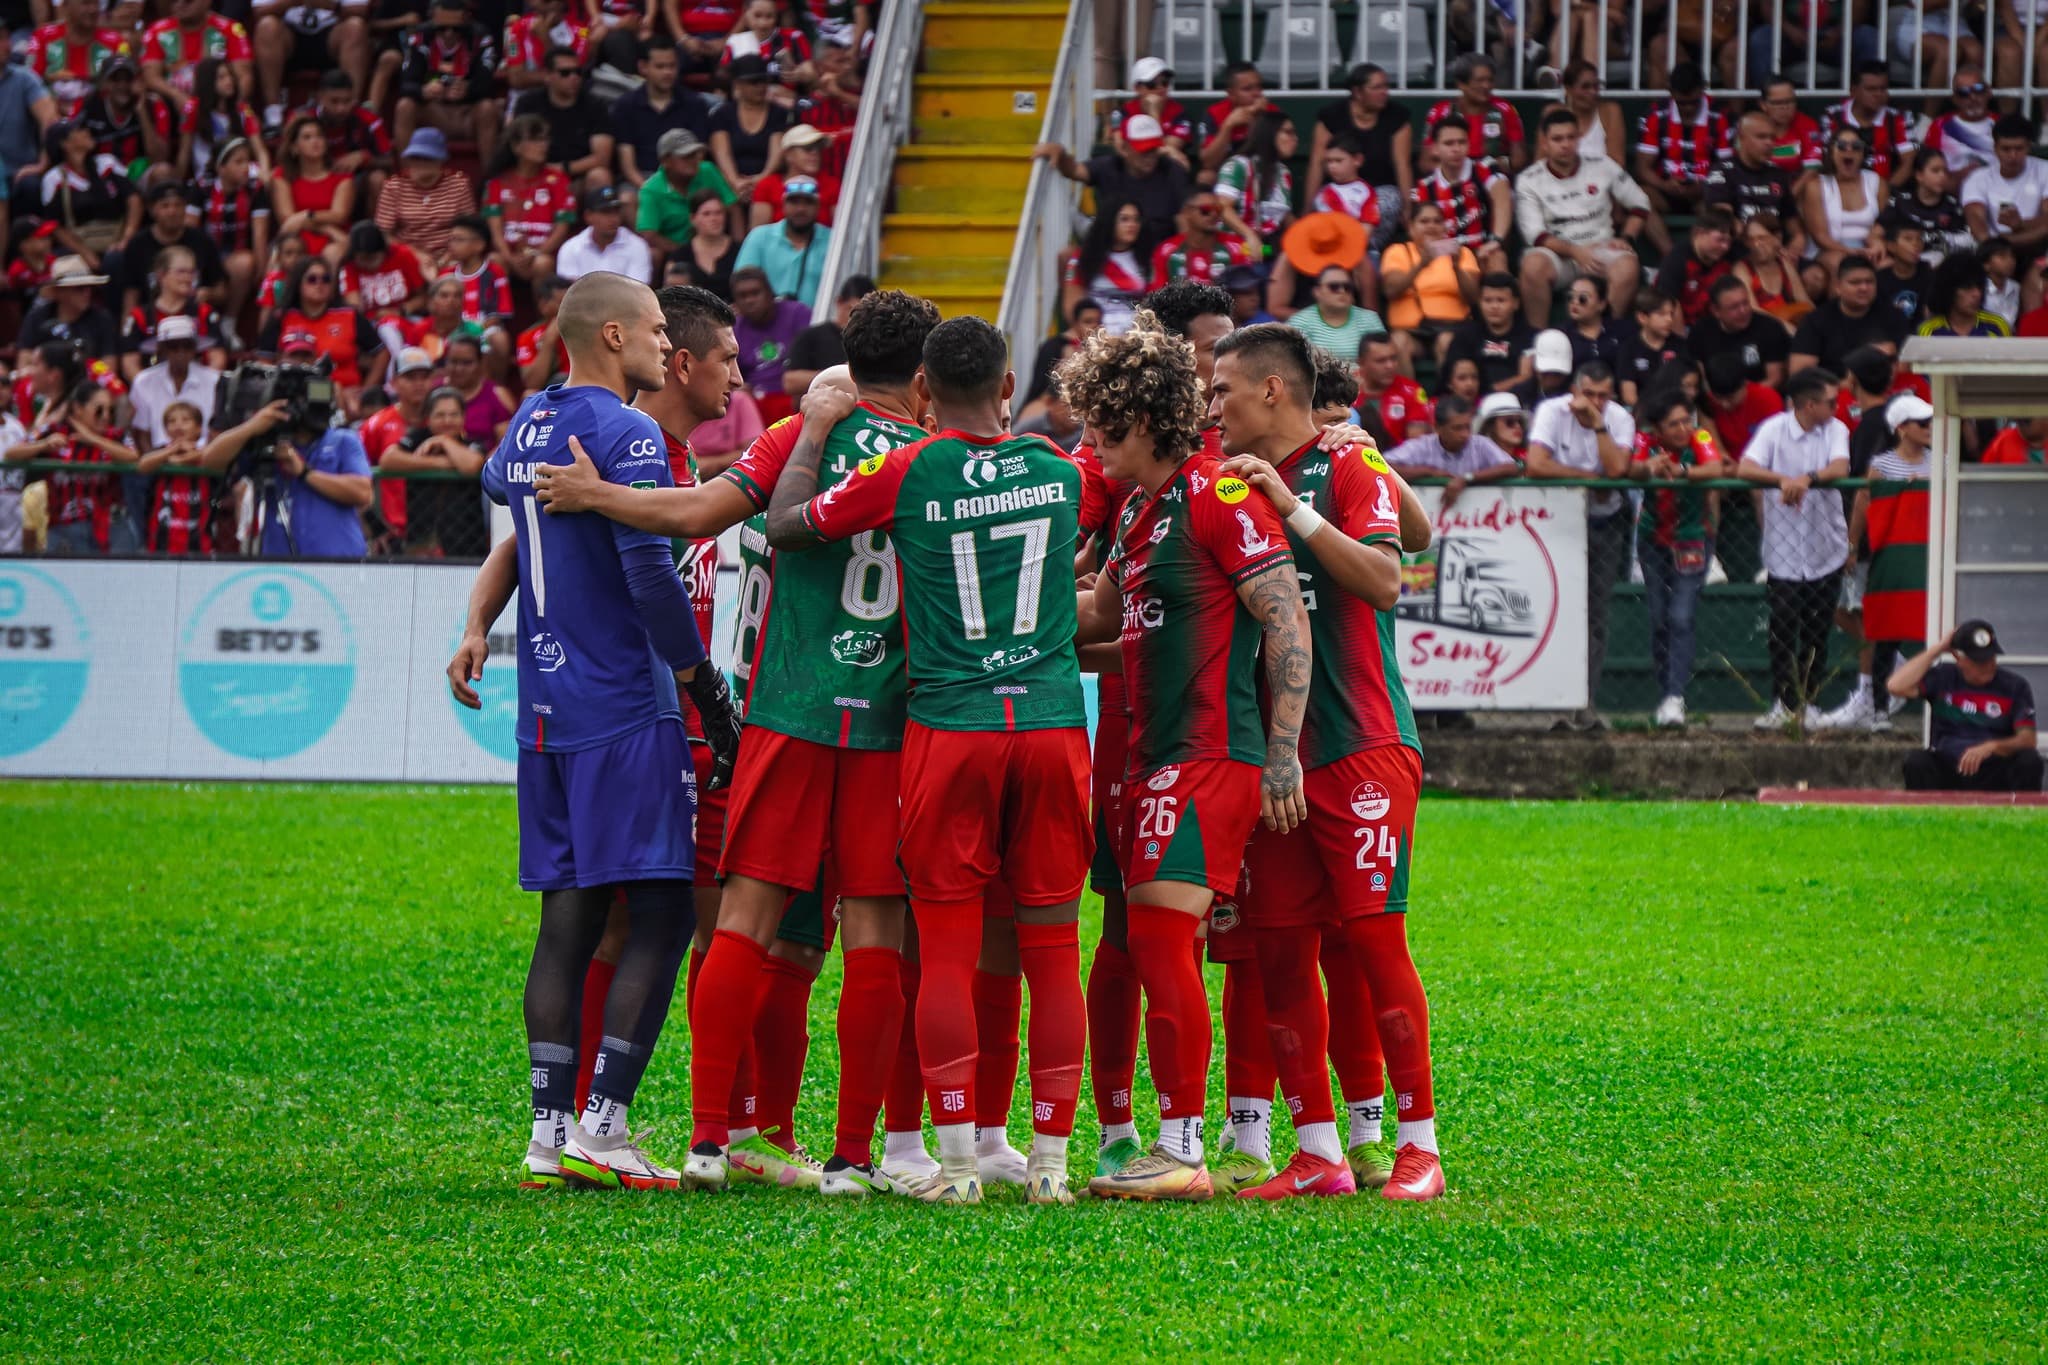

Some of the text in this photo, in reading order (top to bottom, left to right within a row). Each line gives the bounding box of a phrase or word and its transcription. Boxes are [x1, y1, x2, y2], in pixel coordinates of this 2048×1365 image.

[999, 456, 1025, 465] TICO
[1002, 462, 1026, 473] SPORT
[1003, 468, 1029, 478] SOCKS
[953, 482, 1067, 521] RODRÍGUEZ
[1217, 481, 1247, 497] Yale
[523, 495, 546, 617] 1
[840, 529, 900, 621] 8
[951, 517, 1052, 641] 17
[216, 627, 320, 653] BETO'S
[1410, 631, 1506, 678] Samy
[1139, 796, 1178, 839] 26
[1354, 825, 1397, 869] 24
